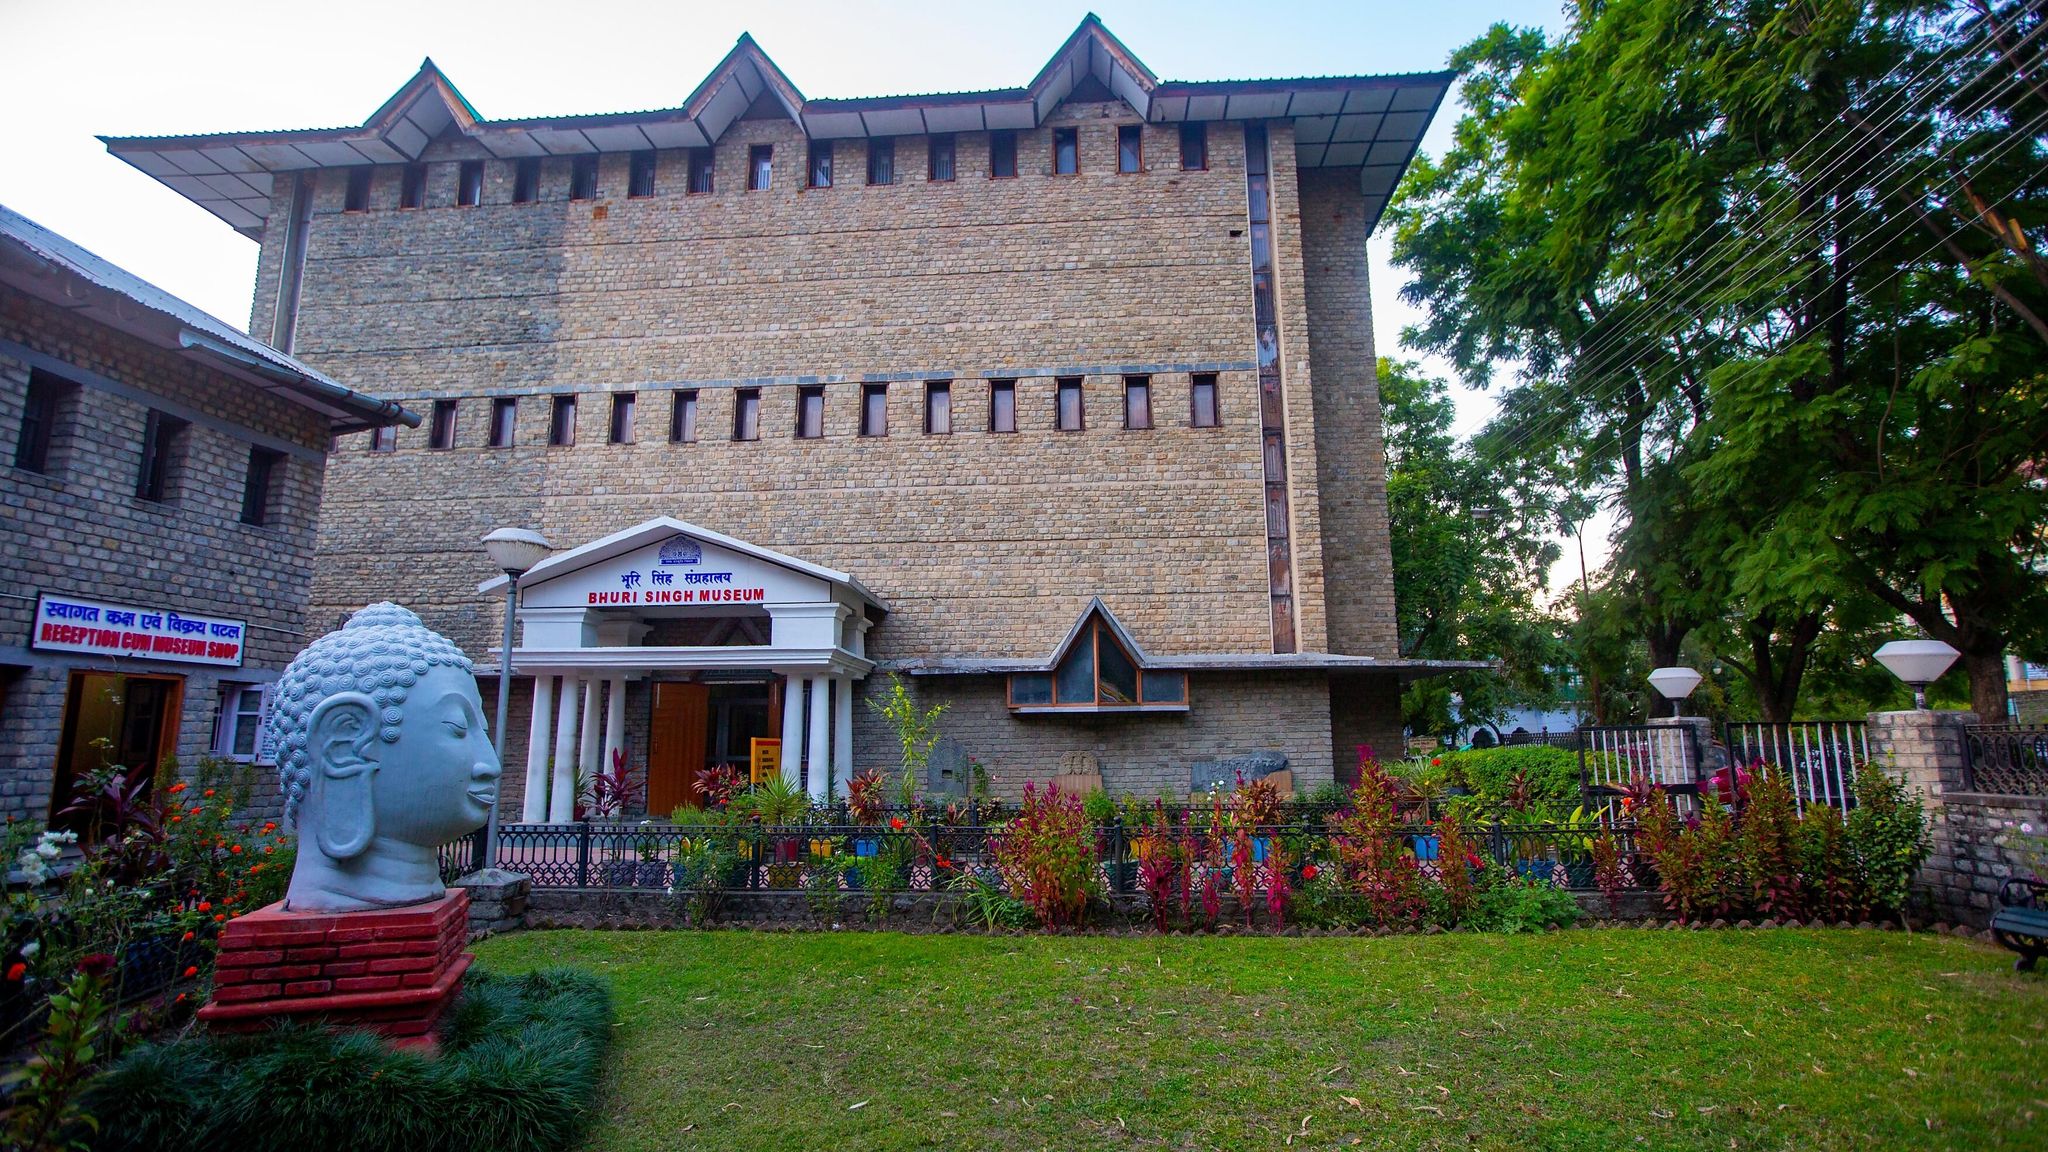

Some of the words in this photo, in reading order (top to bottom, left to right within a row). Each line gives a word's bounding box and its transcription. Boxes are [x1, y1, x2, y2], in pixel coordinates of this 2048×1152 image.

[621, 571, 641, 589] भूरि
[652, 570, 674, 586] सिंह
[685, 569, 732, 584] संग्रहालय
[588, 591, 637, 604] BHURI
[645, 590, 693, 603] SINGH
[699, 588, 764, 602] MUSEUM
[45, 601, 100, 622] स्वागत
[105, 609, 136, 627] कक्ष
[141, 611, 162, 630] एवं
[167, 612, 207, 635] विक्रय
[210, 622, 241, 639] पटल
[41, 622, 121, 648] RECEPTION
[121, 632, 153, 651] CUM
[153, 635, 207, 656] MUSEUM
[208, 641, 240, 659] SHOP
